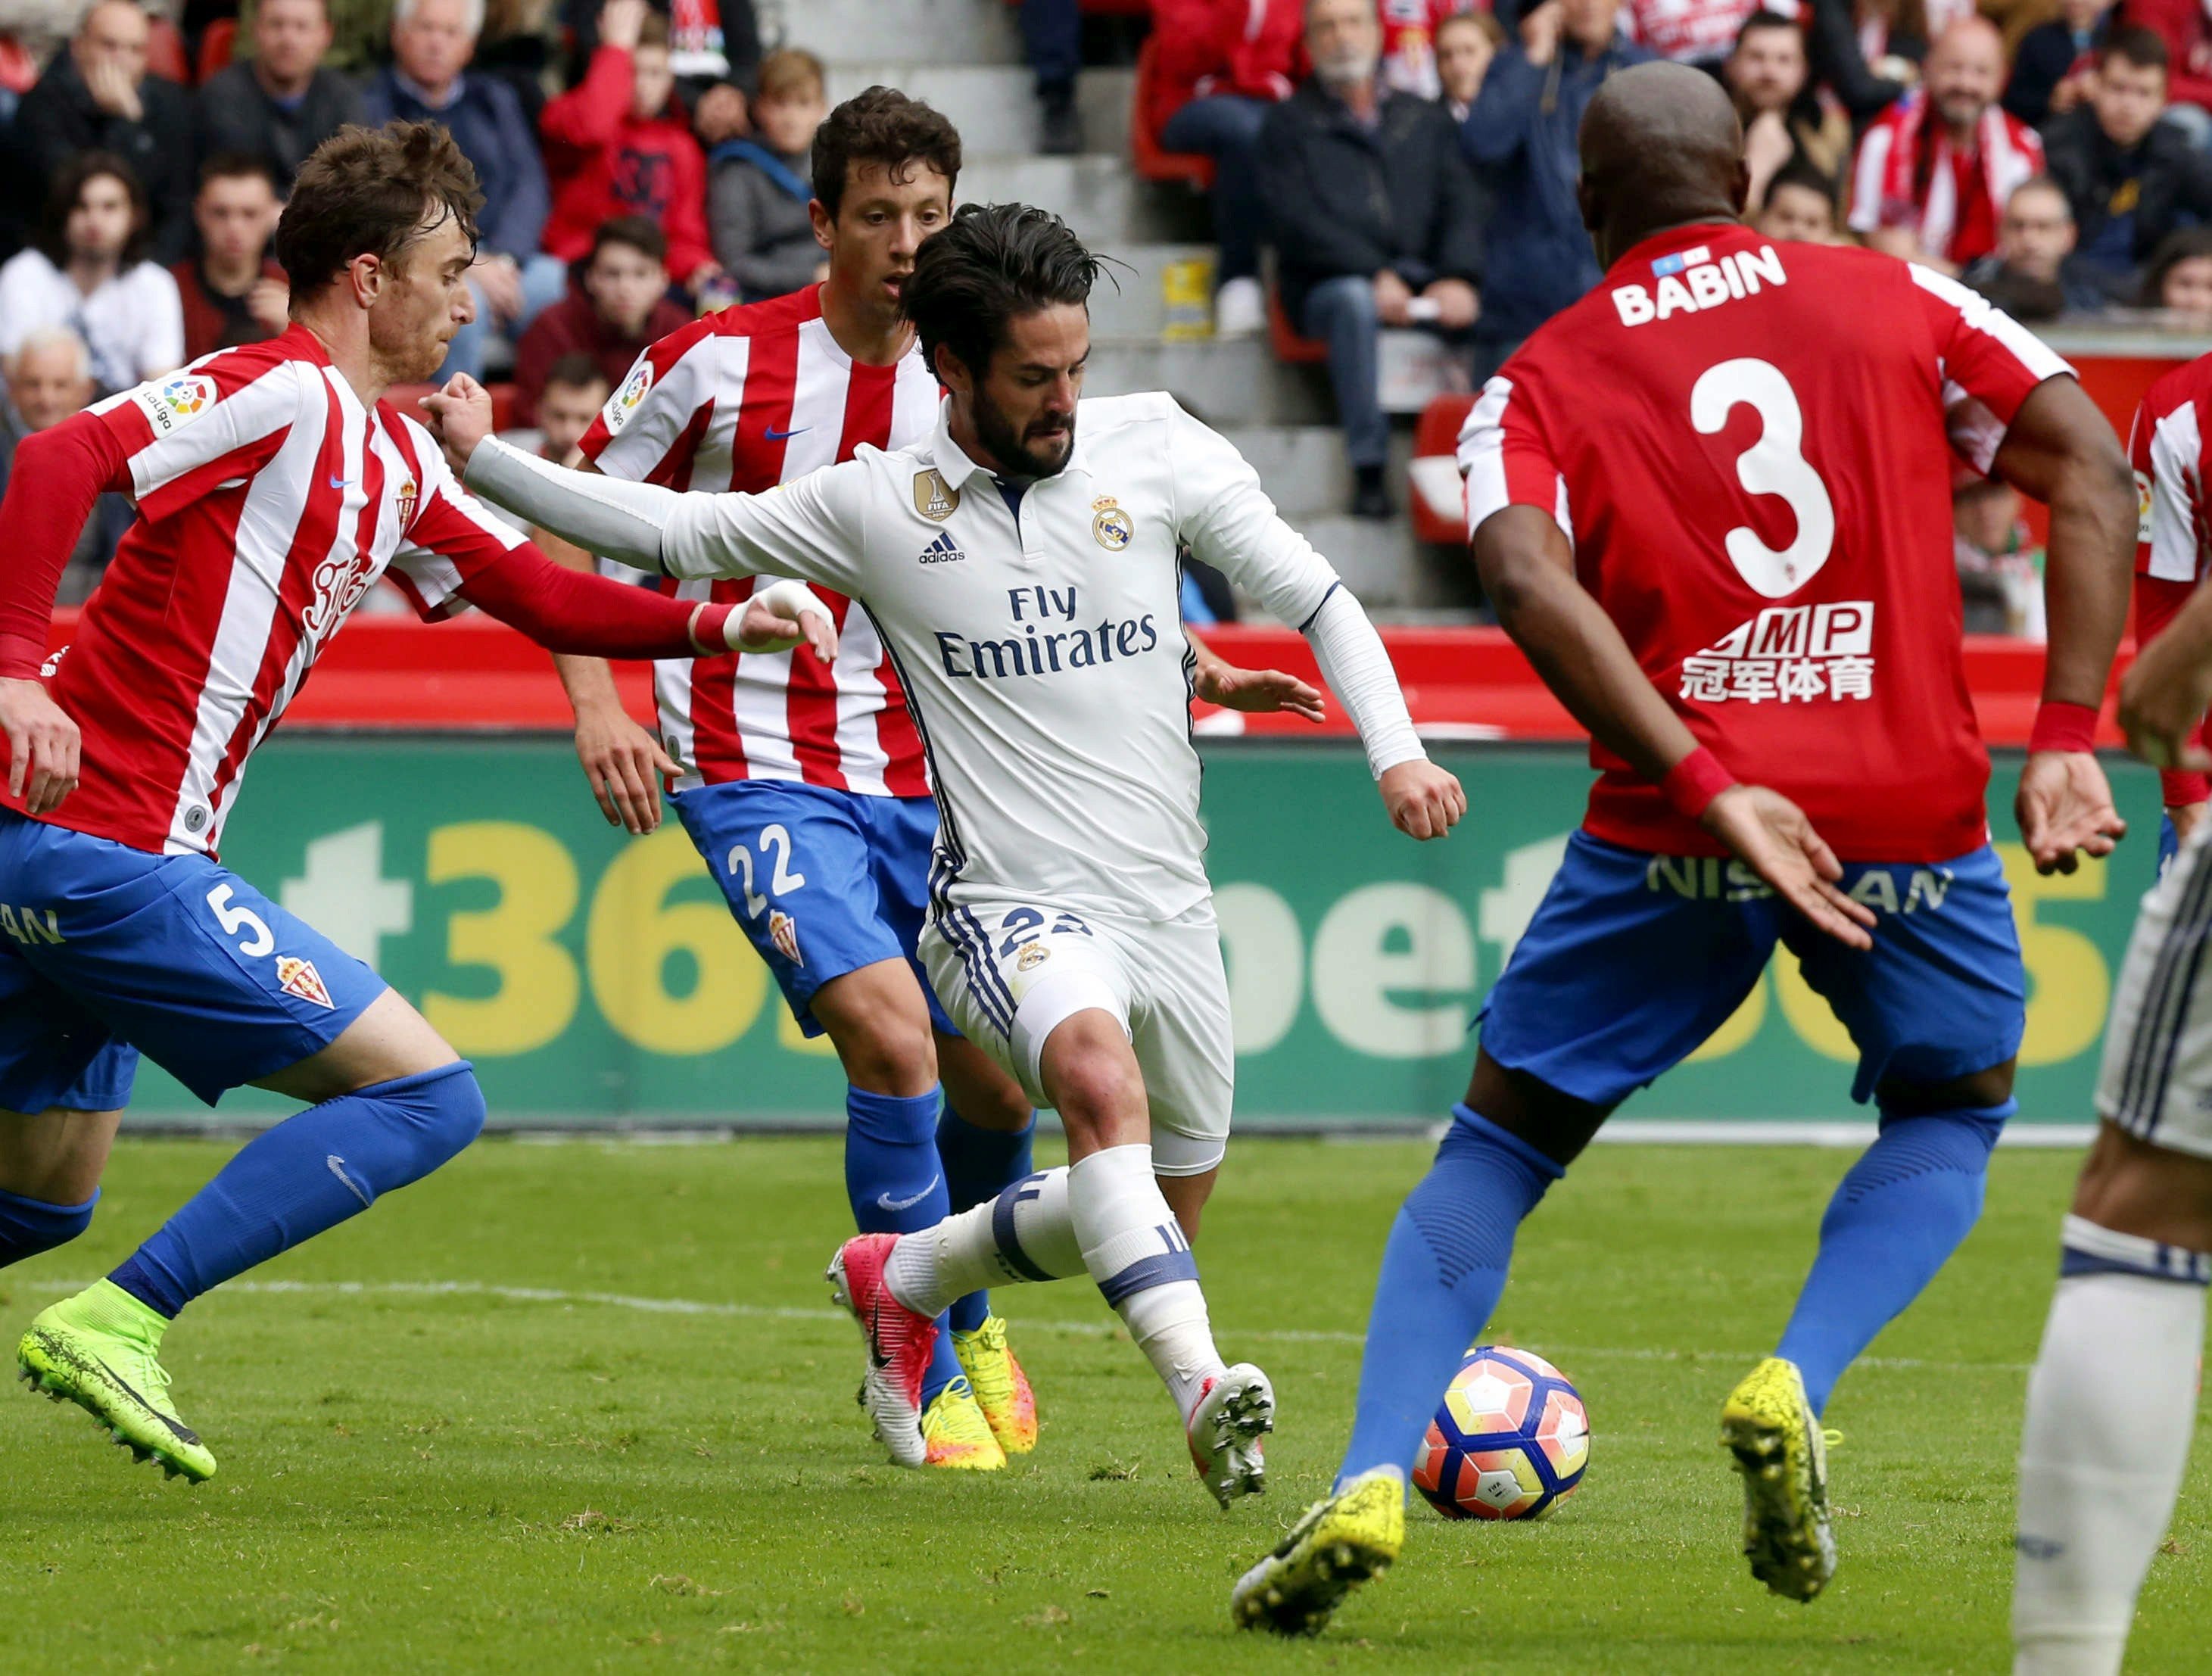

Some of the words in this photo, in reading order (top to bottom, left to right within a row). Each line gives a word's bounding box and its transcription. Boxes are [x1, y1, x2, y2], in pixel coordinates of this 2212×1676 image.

[1611, 245, 1787, 327] BABIN
[143, 391, 172, 430] LaLiga
[927, 502, 950, 511] FIFA
[1690, 357, 1835, 598] 3
[919, 550, 965, 563] adidas
[1008, 585, 1076, 621] Fly
[934, 614, 1157, 678] Emirates
[1678, 656, 1875, 704] 冠军体育
[728, 824, 805, 920] 22
[1646, 854, 1955, 914] NISAN
[207, 883, 275, 957] 5
